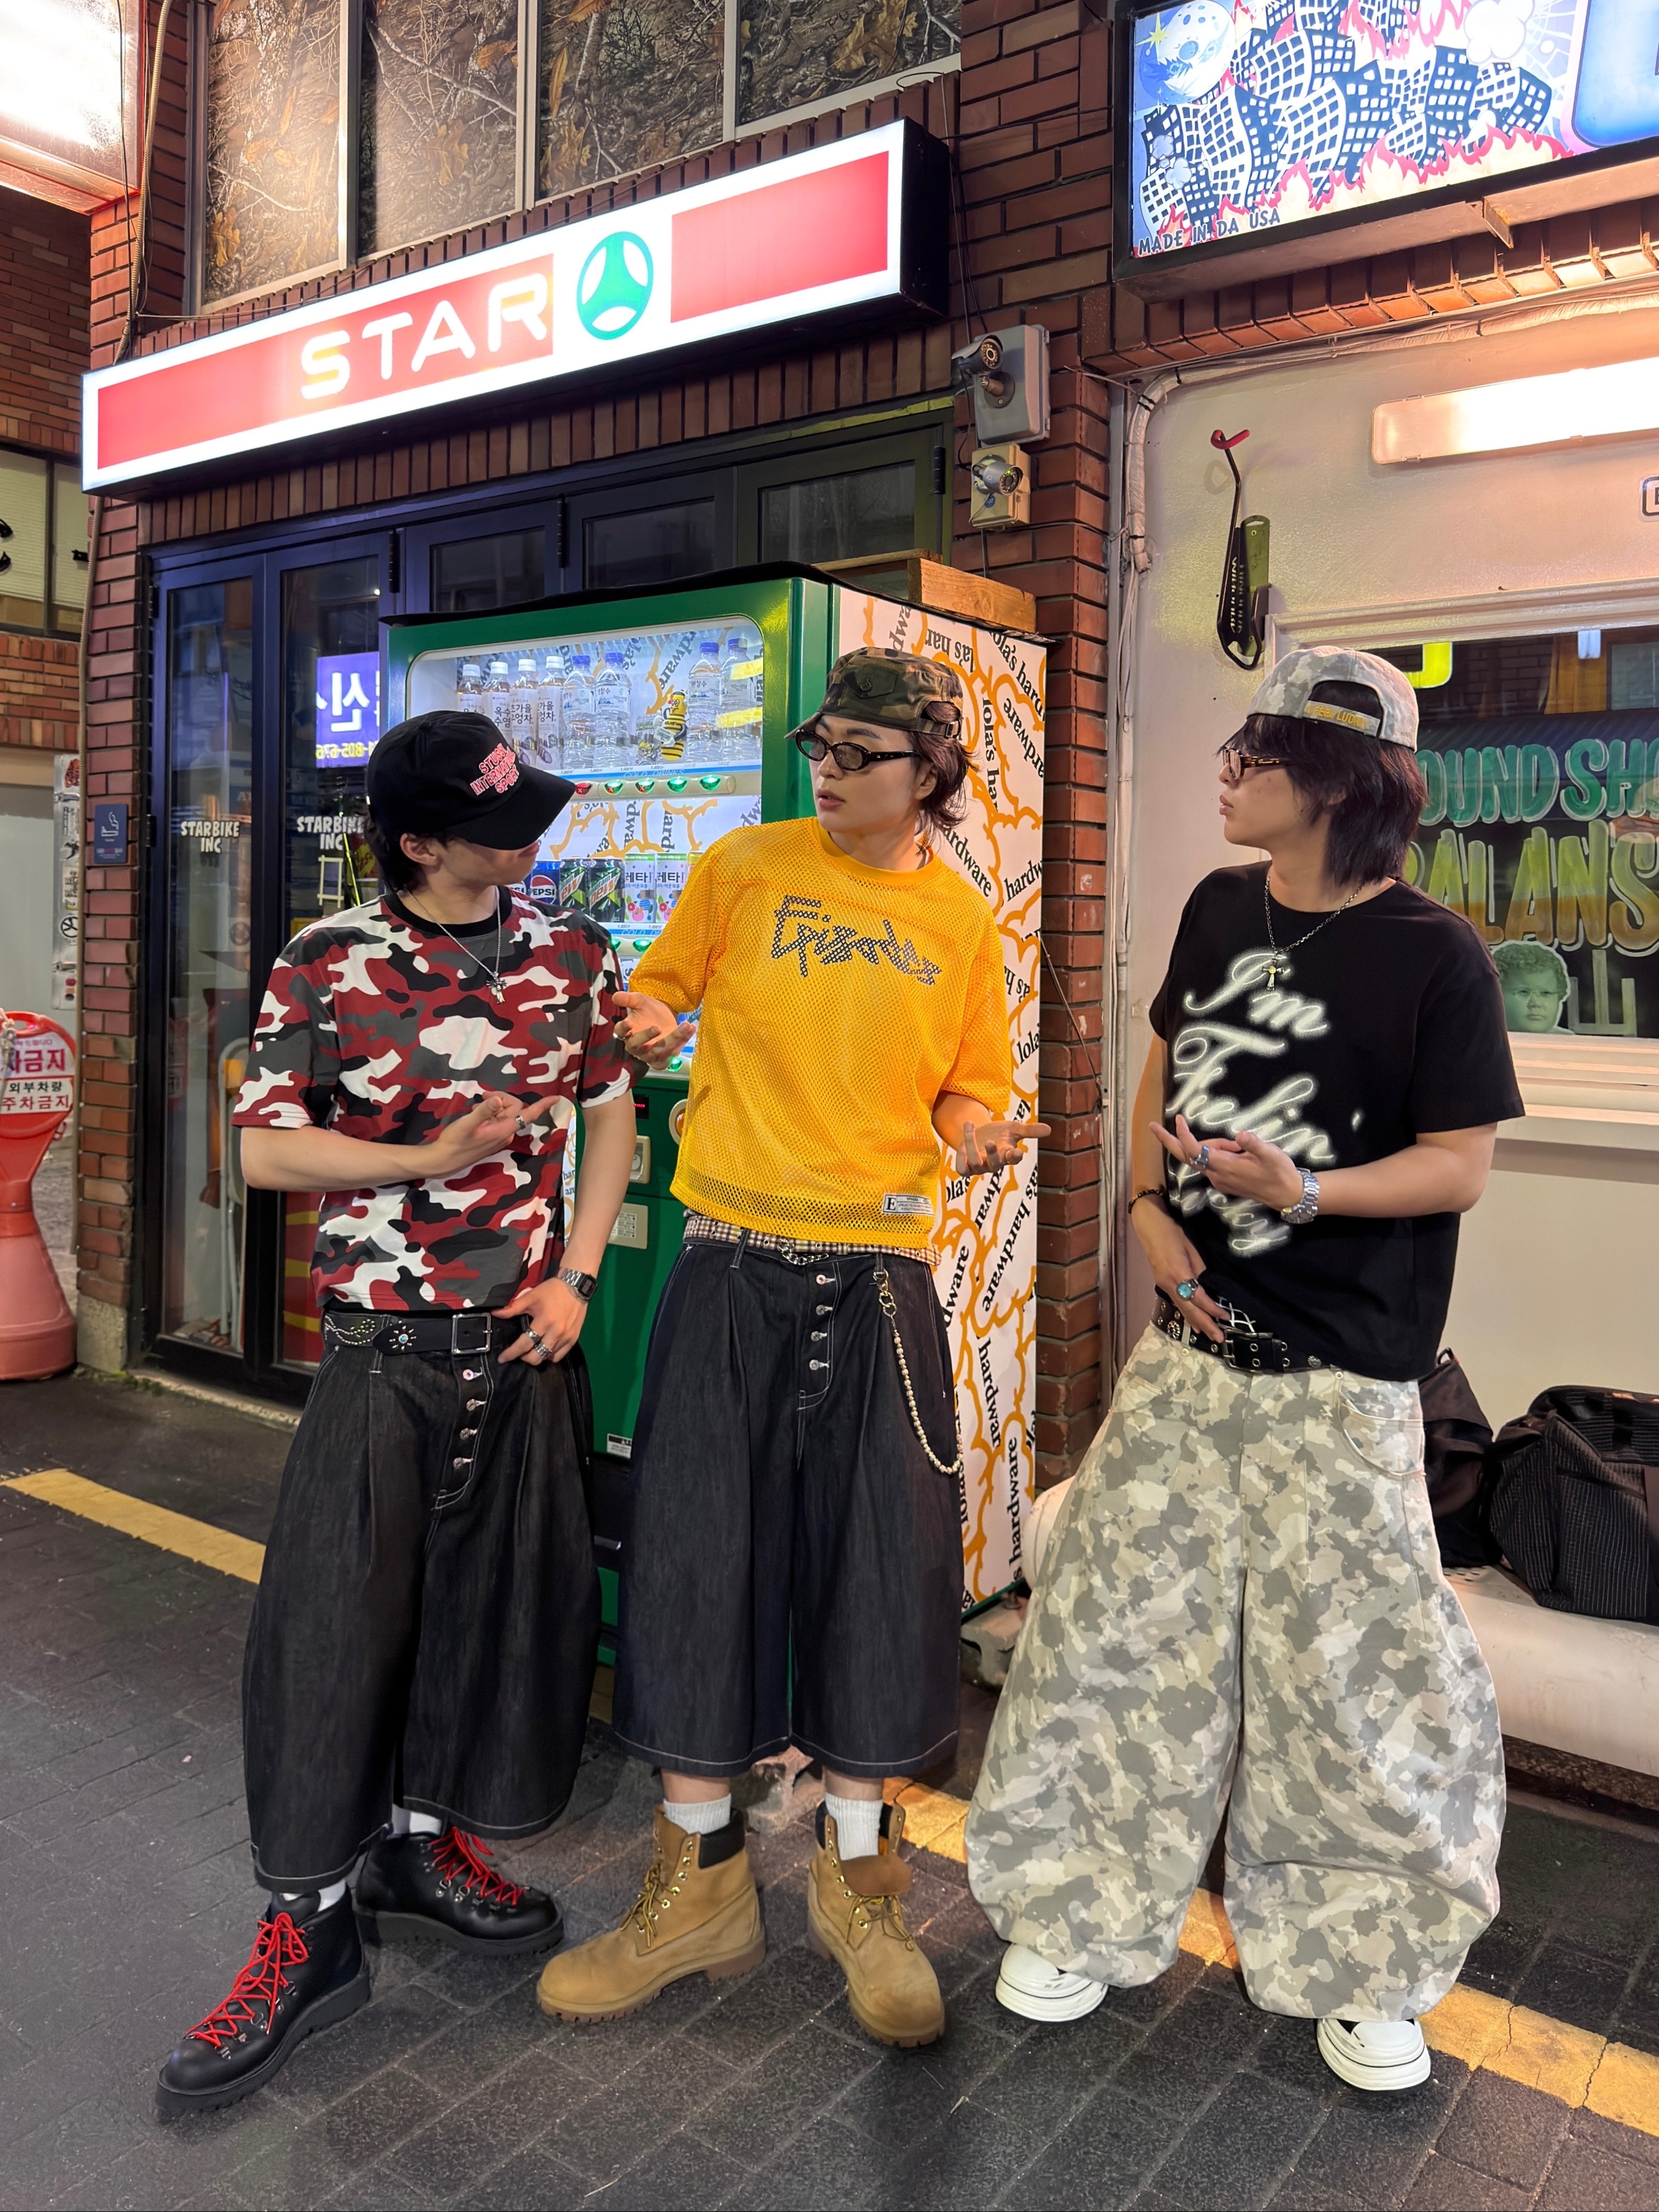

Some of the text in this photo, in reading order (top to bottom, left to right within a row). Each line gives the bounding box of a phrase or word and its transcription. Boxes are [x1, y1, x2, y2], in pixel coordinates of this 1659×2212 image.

[1138, 208, 1280, 256] MADE IN DA USA
[300, 271, 549, 400] STAR
[1313, 706, 1334, 718] FEEL
[1336, 710, 1367, 728] LUCKY
[1003, 698, 1044, 779] ardware
[495, 764, 519, 793] SPORT
[1415, 744, 1560, 828] OUND
[181, 820, 239, 837] STARBIKE
[297, 815, 365, 833] STARBIKE
[201, 837, 221, 853] INC
[320, 833, 343, 850] INC
[626, 872, 652, 883] 레타!
[657, 872, 685, 883] 레타!
[1004, 859, 1042, 902] hardw
[1406, 819, 1659, 958] ALANS
[9, 1081, 62, 1094] 외부차량
[2, 1095, 70, 1111] 주차금지
[886, 1197, 896, 1211] E
[982, 1199, 1031, 1312] hardware
[942, 1246, 970, 1328] dware
[978, 1337, 1001, 1448] hardwar
[1007, 1437, 1022, 1566] hardware
